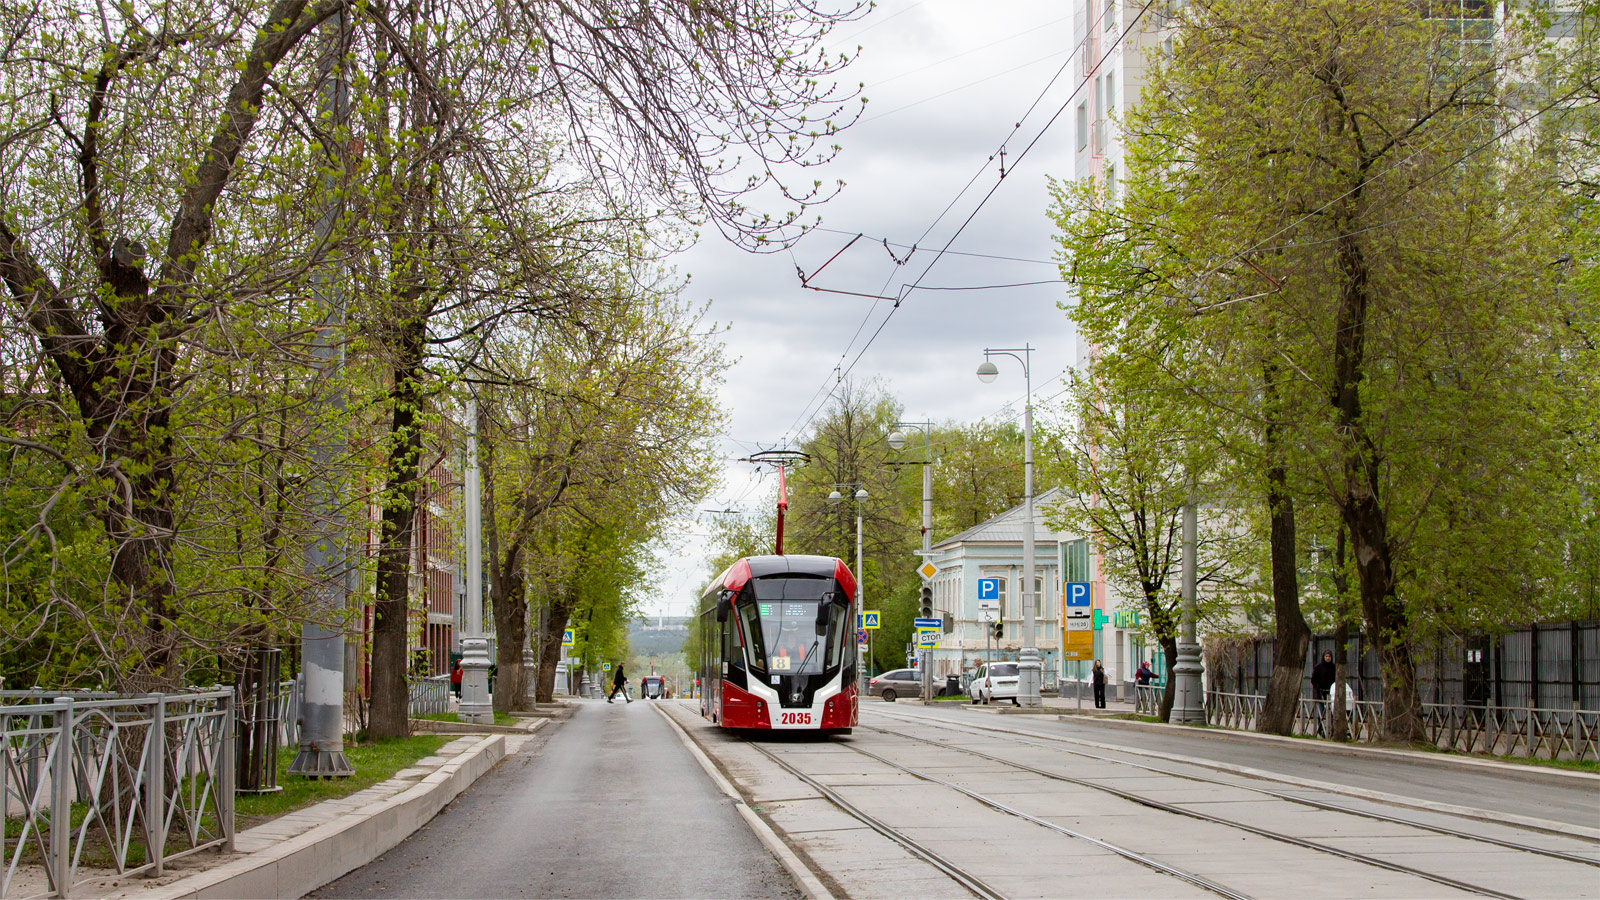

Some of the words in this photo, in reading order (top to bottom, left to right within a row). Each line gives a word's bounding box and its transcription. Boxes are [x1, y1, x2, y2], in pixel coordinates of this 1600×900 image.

[982, 581, 994, 598] P
[1072, 585, 1086, 604] P
[921, 633, 942, 642] СТОП
[776, 658, 786, 669] 8
[781, 712, 812, 725] 2035
